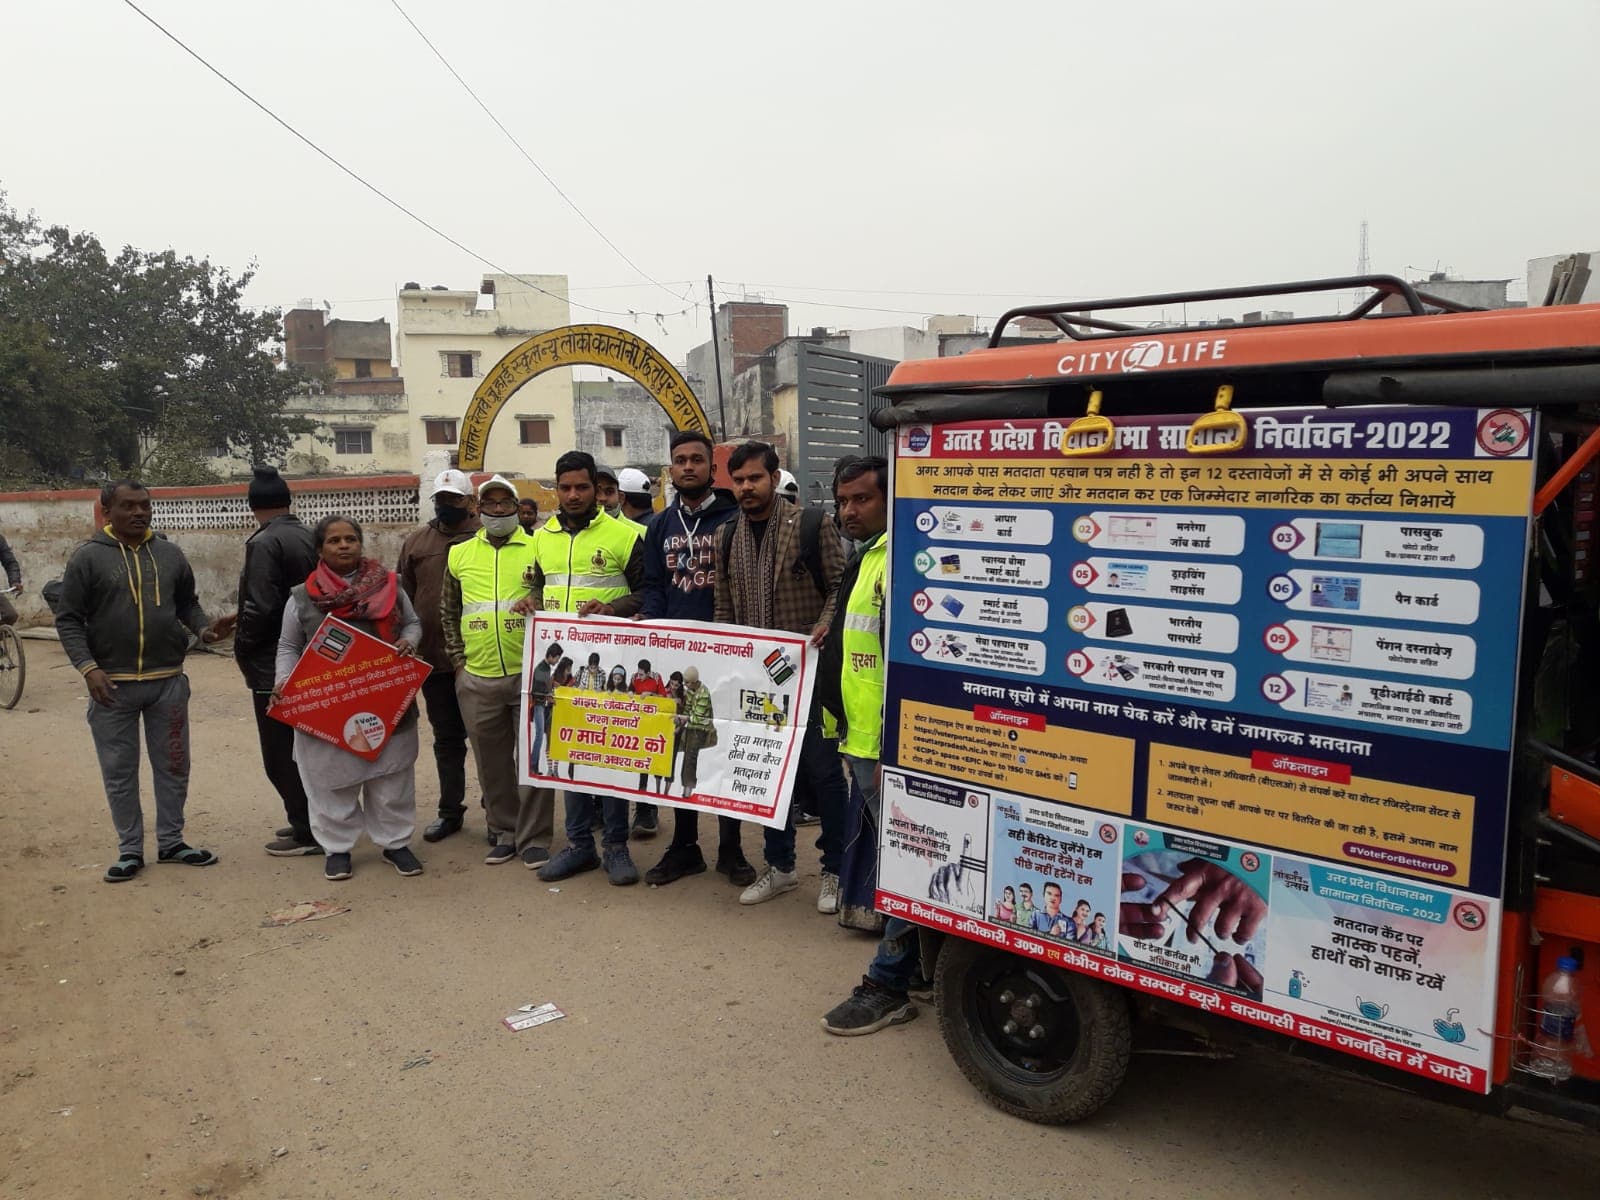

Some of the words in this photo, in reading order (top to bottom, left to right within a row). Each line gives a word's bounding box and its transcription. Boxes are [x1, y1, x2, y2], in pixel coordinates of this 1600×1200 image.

[1057, 350, 1119, 374] CITY
[1167, 340, 1227, 364] LIFE
[942, 428, 984, 451] उत्तर
[990, 423, 1036, 451] प्रदेश
[915, 466, 939, 477] अगर
[944, 463, 974, 477] आपके
[978, 467, 998, 478] पास
[1002, 467, 1045, 478] मतदाता
[1050, 467, 1088, 479] पहचान
[1094, 467, 1113, 479] पत्र
[1117, 463, 1140, 478] नहीं
[1145, 463, 1154, 479] है
[1160, 463, 1174, 479] तो
[1180, 468, 1200, 480] इन
[1207, 468, 1223, 479] 12
[1298, 464, 1312, 481] में
[1318, 465, 1333, 481] से
[1339, 463, 1372, 485] कोई
[1378, 464, 1398, 482] भी
[1404, 465, 1448, 484] अपने
[1455, 470, 1494, 484] साथ
[932, 485, 968, 496] मतदान
[998, 484, 1026, 497] लेकर
[1058, 482, 1081, 498] और
[1086, 487, 1129, 499] मतदान
[1134, 489, 1154, 500] कर
[1160, 489, 1183, 502] एक
[1255, 486, 1313, 503] नागरिक
[1319, 492, 1340, 505] का
[1346, 488, 1393, 506] कर्तव्य
[920, 517, 930, 526] 01
[1078, 525, 1091, 534] 02
[1176, 520, 1206, 532] मनरेगा
[1192, 536, 1211, 548] कार्ड
[1400, 526, 1443, 541] पासबुक
[1277, 532, 1292, 543] 03
[917, 558, 928, 566] 04
[1076, 570, 1089, 579] 05
[1273, 583, 1289, 593] 06
[916, 598, 926, 607] 07
[1002, 598, 1018, 610] कार्ड
[1395, 590, 1411, 606] पैन
[1415, 593, 1439, 607] कार्ड
[1074, 614, 1086, 623] 08
[567, 627, 611, 645] विधानसभा
[614, 634, 646, 647] सामान्य
[649, 632, 685, 651] निर्वाचन
[915, 638, 923, 647] 10
[1168, 632, 1203, 644] पासपोर्ट
[1270, 633, 1286, 644] 09
[851, 652, 877, 672] सुरक्षा
[1073, 658, 1082, 668] 11
[1143, 660, 1175, 673] सरकारी
[1178, 665, 1208, 677] पहचान
[1210, 669, 1224, 679] पत्र
[1269, 684, 1282, 693] 12
[1370, 685, 1425, 704] यूडीआईडी
[1428, 692, 1454, 706] कार्ड
[604, 698, 640, 713] लोकतंत्र
[642, 703, 657, 714] का
[360, 716, 377, 725] Vote
[962, 681, 1005, 701] मतदाता
[1008, 685, 1035, 708] सूची
[1038, 686, 1050, 706] में
[1053, 695, 1089, 713] अपना
[1093, 700, 1119, 717] नाम
[1122, 702, 1149, 722] चेक
[1152, 704, 1176, 726] करें
[1179, 708, 1207, 731] और
[1210, 714, 1236, 736] बनें
[1309, 732, 1373, 757] मतदाता
[989, 710, 1029, 727] ऑनलाइन
[560, 727, 574, 741] 07
[577, 726, 608, 746] मार्च
[734, 733, 750, 748] युवा
[611, 733, 640, 751] 2022
[644, 734, 667, 754] को
[753, 737, 783, 750] मतदाता
[568, 749, 602, 763] मतदान
[728, 747, 745, 761] होने
[747, 751, 759, 761] का
[634, 756, 652, 770] करें
[1272, 756, 1328, 777] ऑफलाइन
[733, 766, 761, 780] मतदान
[732, 780, 747, 793] लिए
[1451, 808, 1461, 820] से
[1008, 828, 1025, 841] सही
[1086, 847, 1103, 860] हम
[1408, 836, 1435, 849] अपना
[1022, 846, 1056, 863] मतदान
[1058, 852, 1073, 867] देने
[1074, 858, 1083, 870] से
[1349, 845, 1449, 873] #VoteForBetterUP
[1014, 856, 1033, 870] पीछे
[1034, 862, 1054, 876] नहीं
[1077, 875, 1093, 886] हम
[1326, 871, 1347, 884] उत्तर
[1350, 876, 1374, 891] प्रदेश
[1376, 880, 1434, 904] विधानसभा
[1319, 886, 1359, 903] सामान्य
[1413, 908, 1442, 922] 2022
[1333, 915, 1379, 936] मतदान
[1381, 925, 1403, 943] केंद्र
[1406, 933, 1424, 947] पर
[1133, 939, 1147, 950] वोट
[1148, 944, 1164, 955] देना
[1331, 931, 1378, 955] मास्क
[1311, 945, 1347, 966] हाथों
[1348, 953, 1372, 972] को
[1149, 955, 1180, 972] अधिकार
[1181, 961, 1191, 974] भी
[881, 896, 908, 912] मुख्य
[911, 902, 953, 927] निर्वाचन
[955, 918, 1010, 946] अधिकारी,
[1047, 948, 1060, 961] एवं
[1063, 950, 1100, 973] क्षेत्रीय
[1103, 962, 1136, 982] लोक
[1138, 973, 1186, 997] सम्पर्क
[1230, 1001, 1295, 1031] वाराणसी
[1298, 1020, 1333, 1043] द्वारा
[1336, 1034, 1402, 1063] जनहित
[1407, 1050, 1427, 1070] में
[1429, 1061, 1473, 1085] जारी
